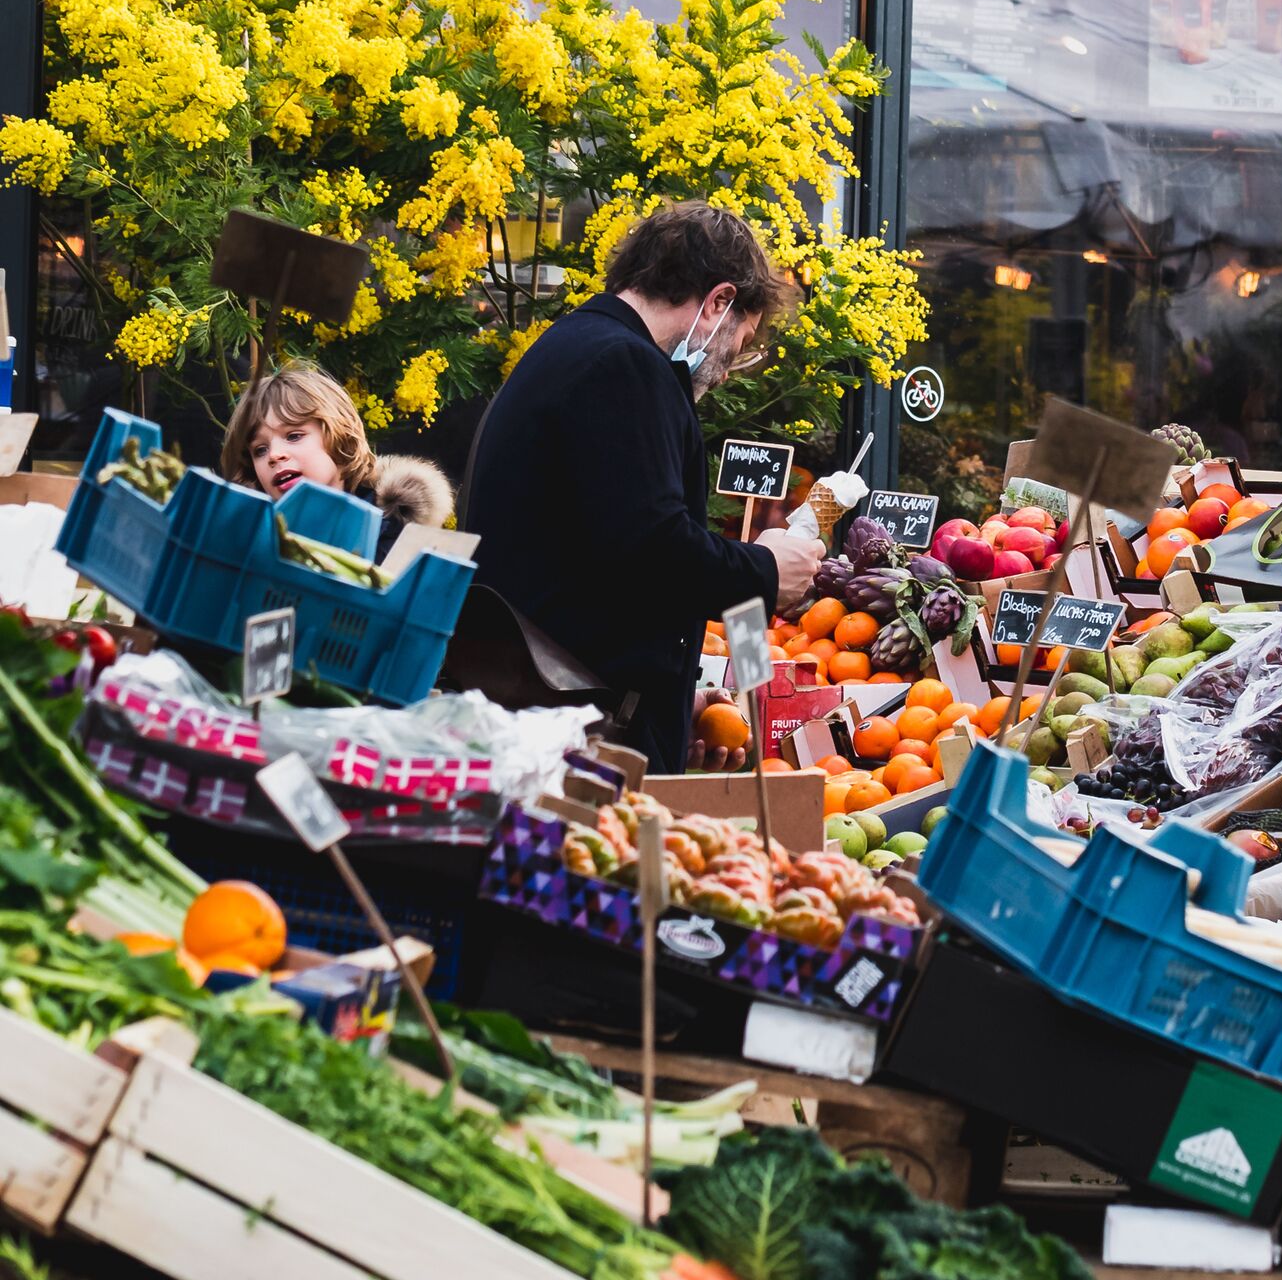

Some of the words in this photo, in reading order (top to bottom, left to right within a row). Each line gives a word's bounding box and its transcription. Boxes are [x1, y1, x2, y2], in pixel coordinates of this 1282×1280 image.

[874, 493, 899, 509] GALA
[901, 496, 934, 511] GALAXY
[1054, 604, 1085, 619] LUCAS
[995, 620, 1006, 642] 5
[771, 719, 802, 729] FRUITS
